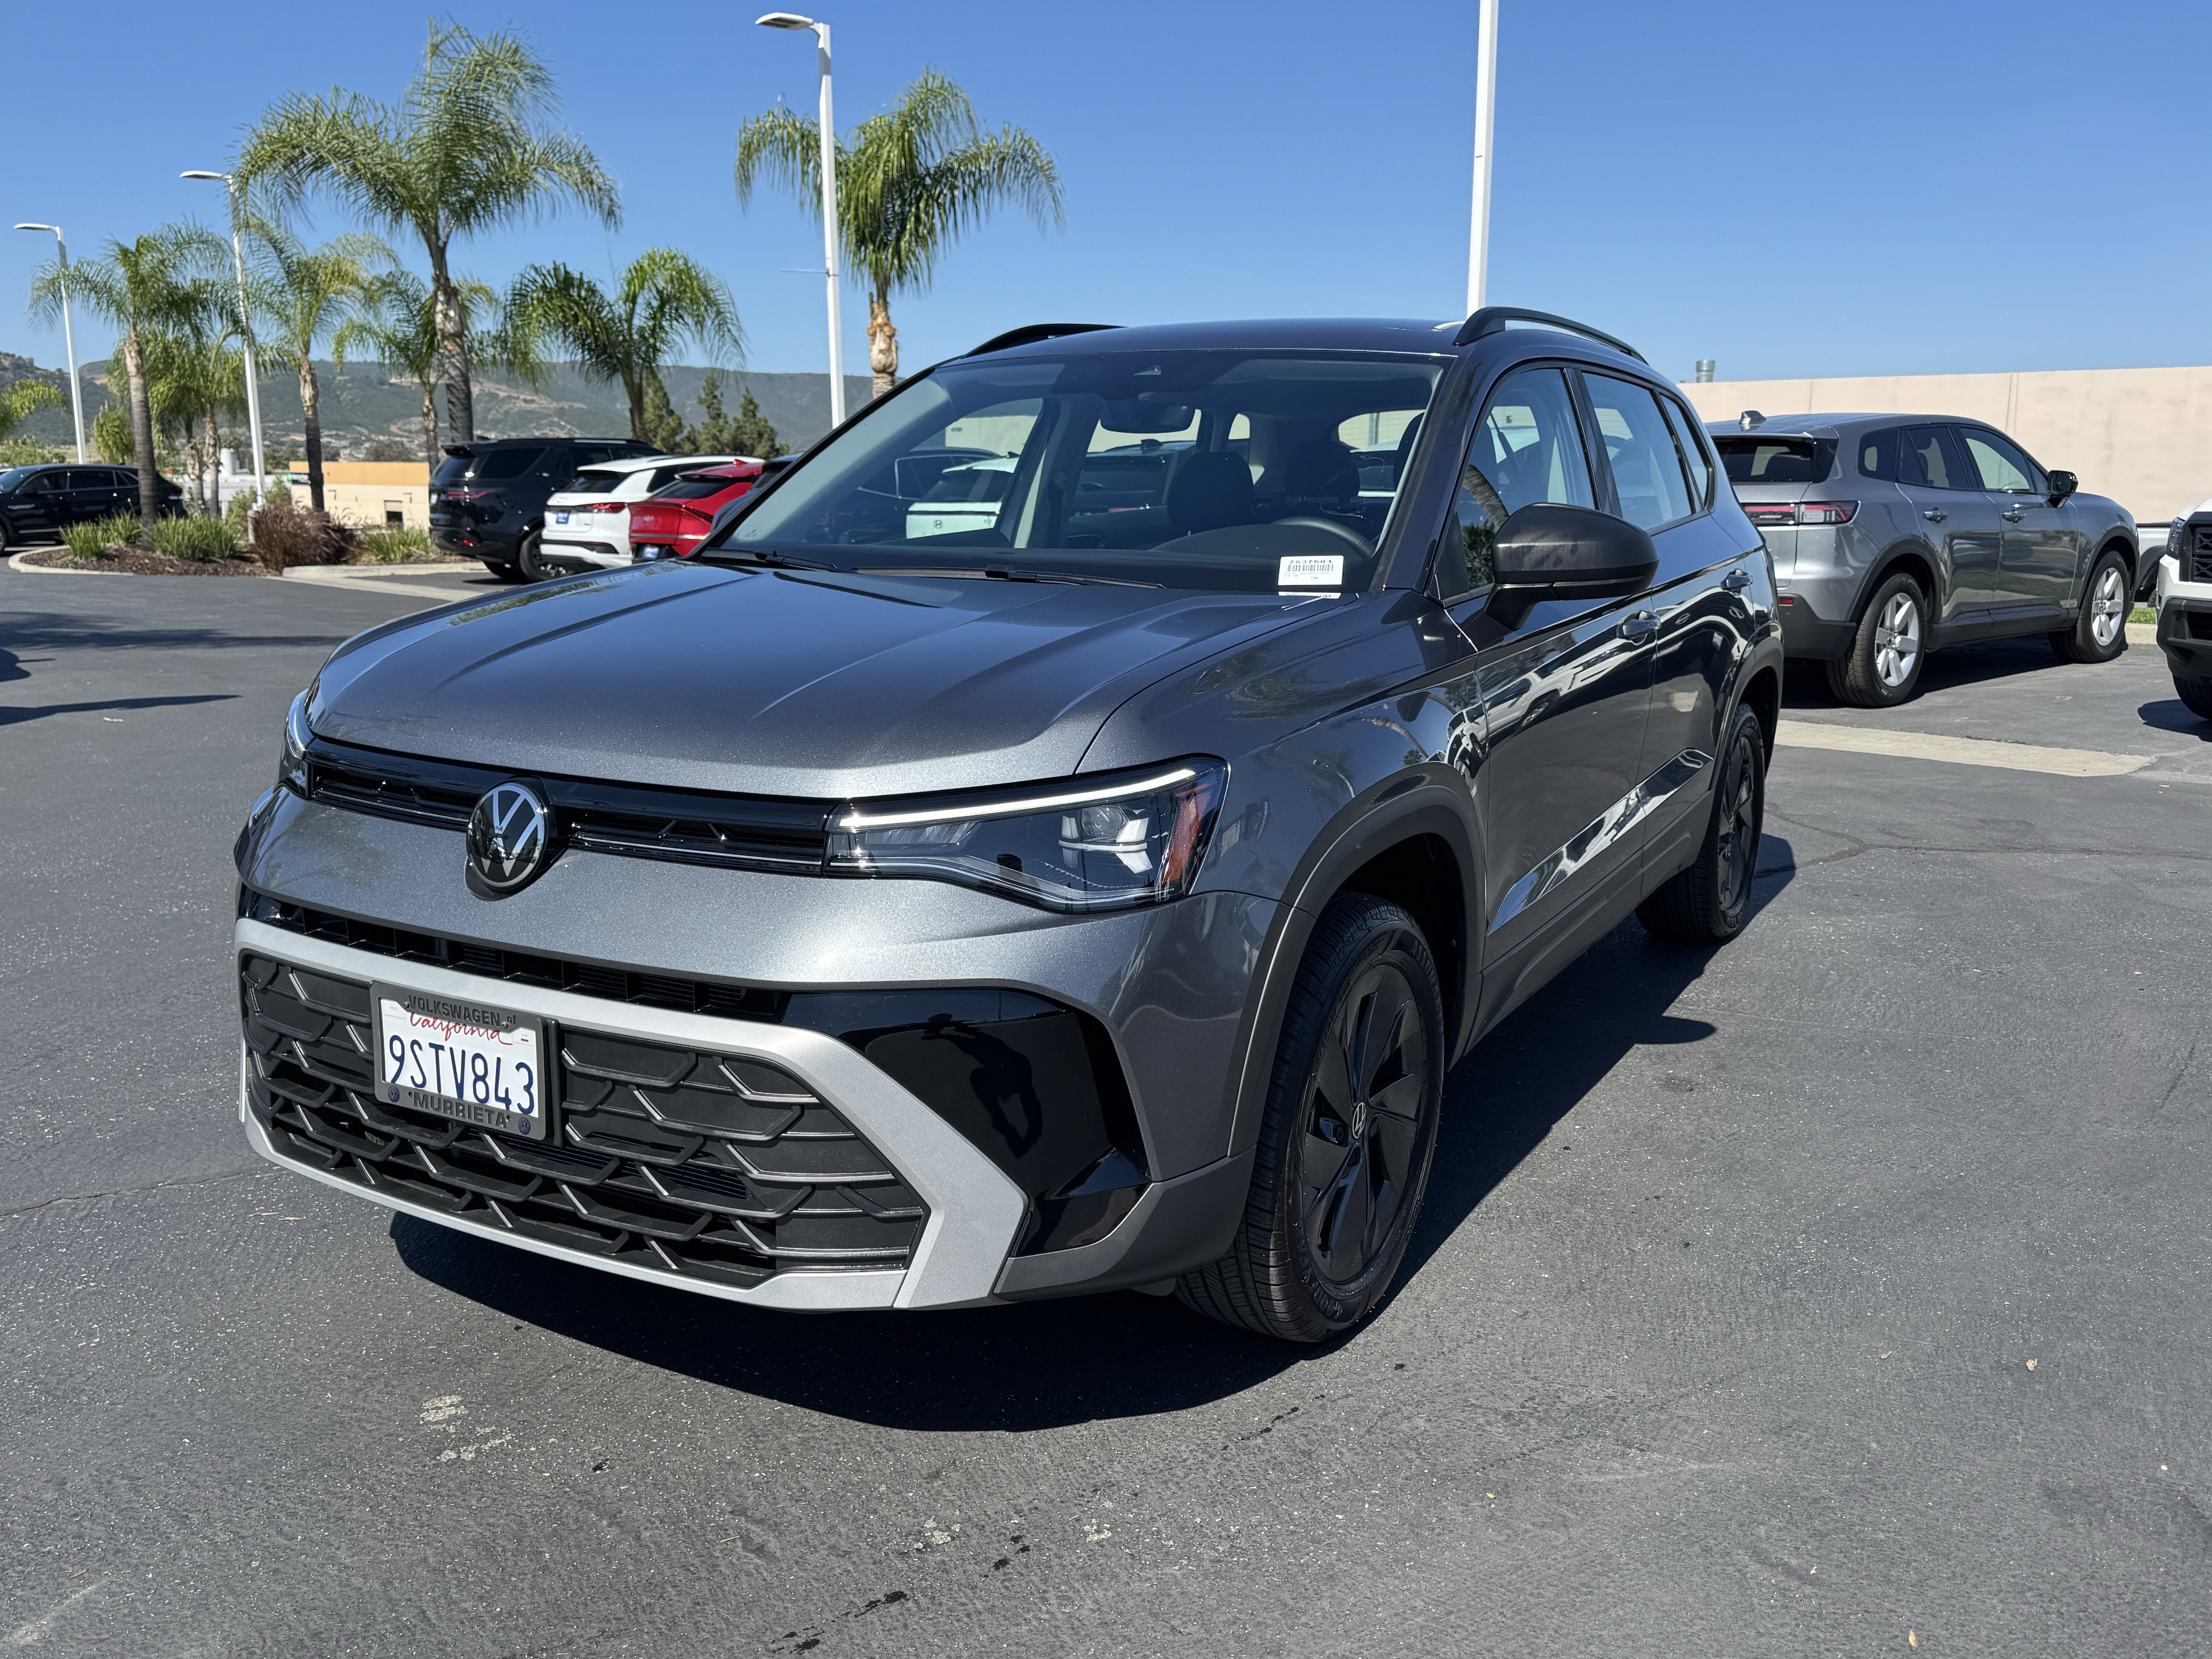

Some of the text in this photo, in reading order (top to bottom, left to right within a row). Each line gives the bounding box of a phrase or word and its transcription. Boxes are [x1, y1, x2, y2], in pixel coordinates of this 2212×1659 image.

[409, 995, 500, 1027] VOLKSWAGEN
[389, 1035, 534, 1115] 9STV843
[414, 1092, 507, 1128] MURRIETA
